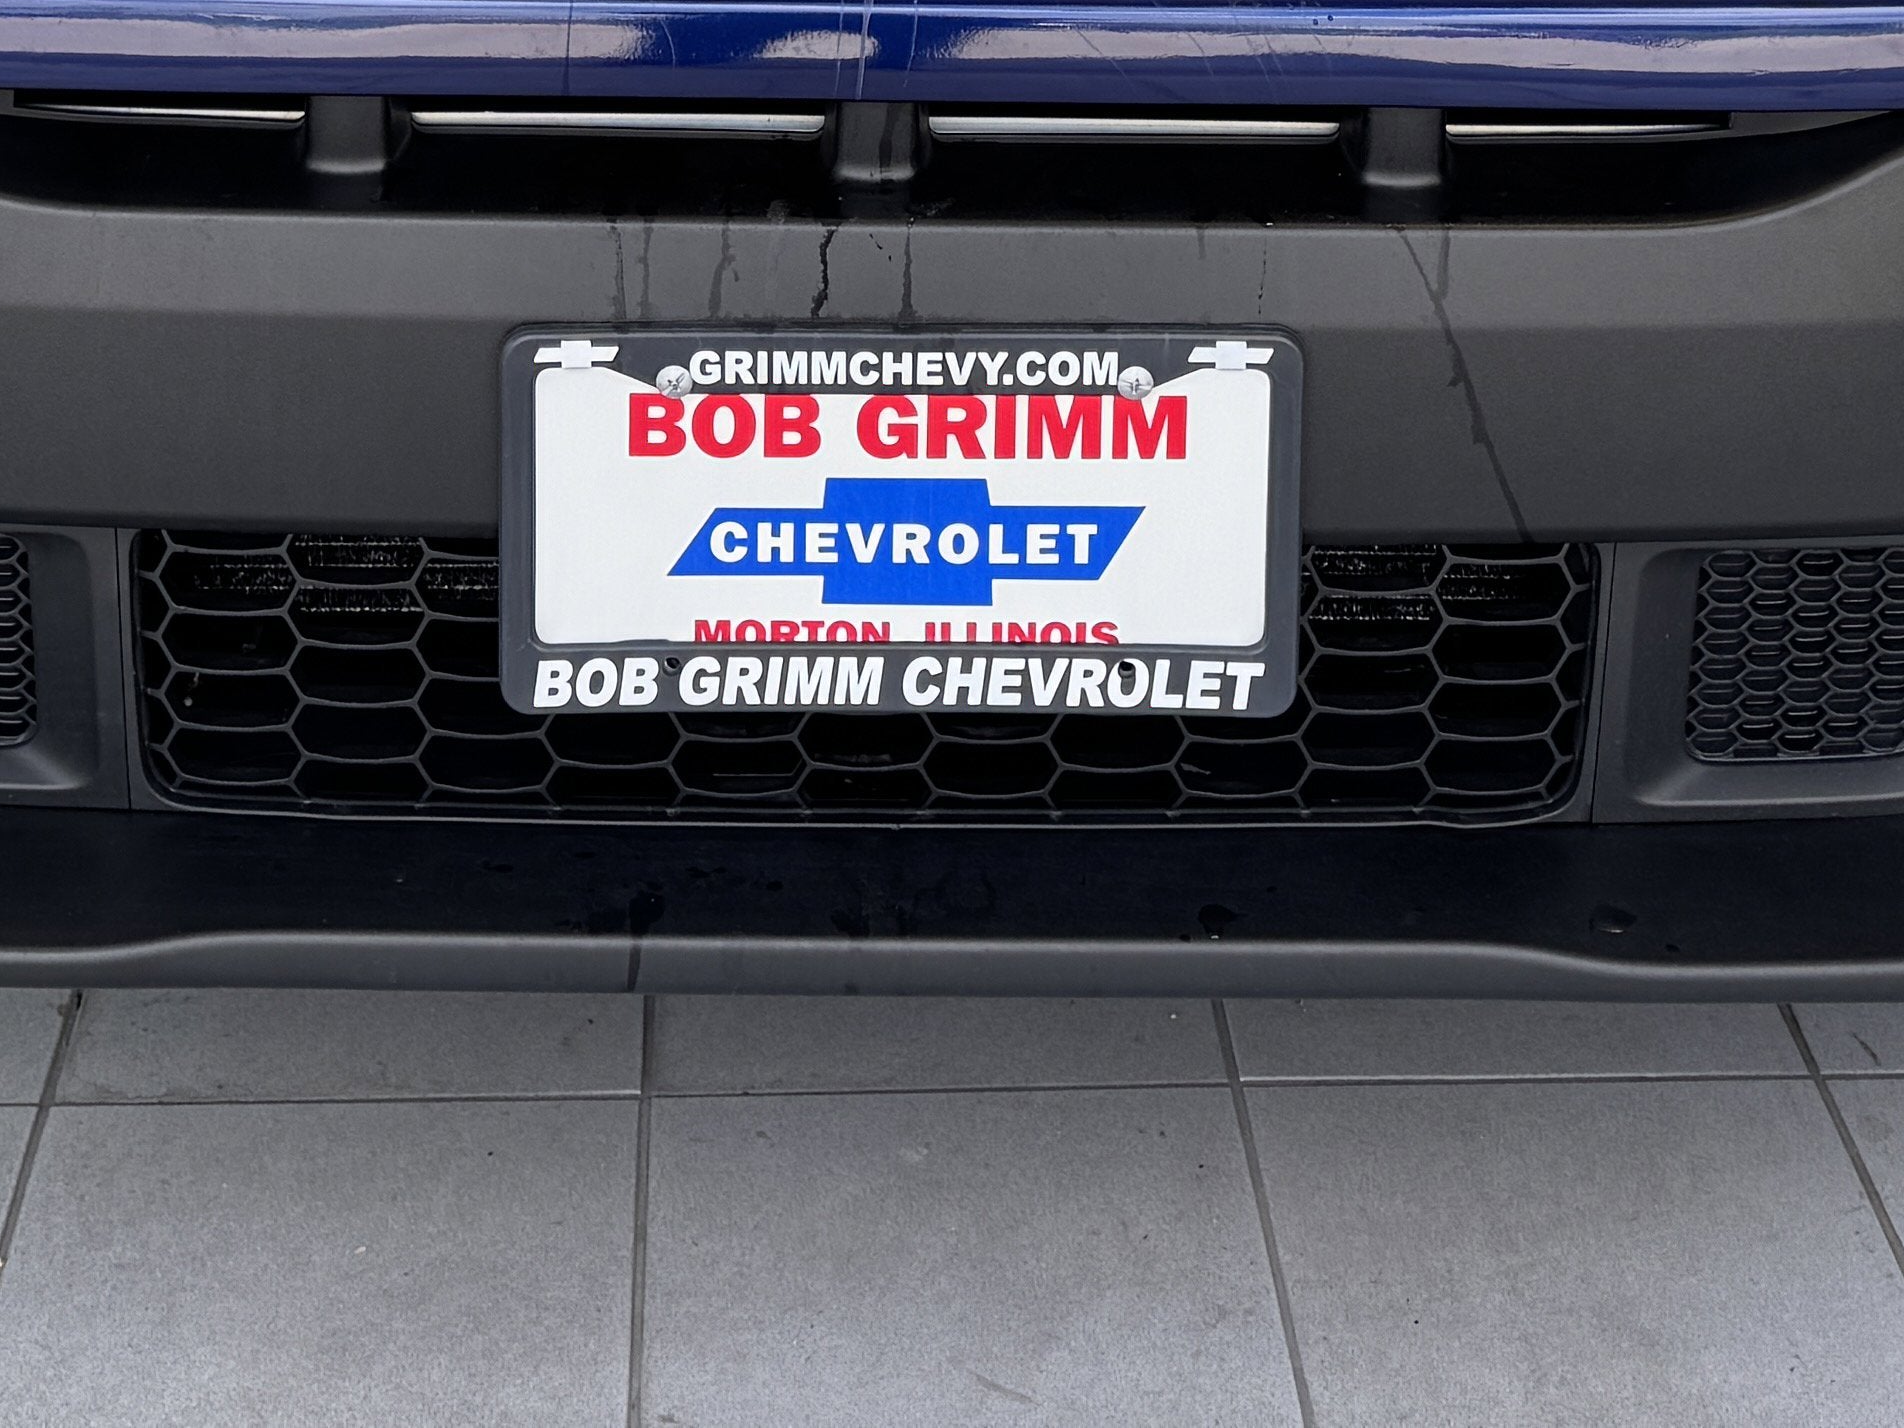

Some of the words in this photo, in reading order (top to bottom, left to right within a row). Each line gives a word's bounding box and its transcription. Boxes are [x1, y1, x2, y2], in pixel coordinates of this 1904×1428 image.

[689, 350, 1120, 386] GRIMMCHEVY.COM
[628, 393, 822, 459] BOB
[856, 394, 1188, 460] GRIMM
[709, 520, 1099, 565] CHEVROLET
[533, 656, 660, 708] BOB
[678, 655, 885, 706] GRIMM
[902, 656, 1266, 711] CHEVROLET
